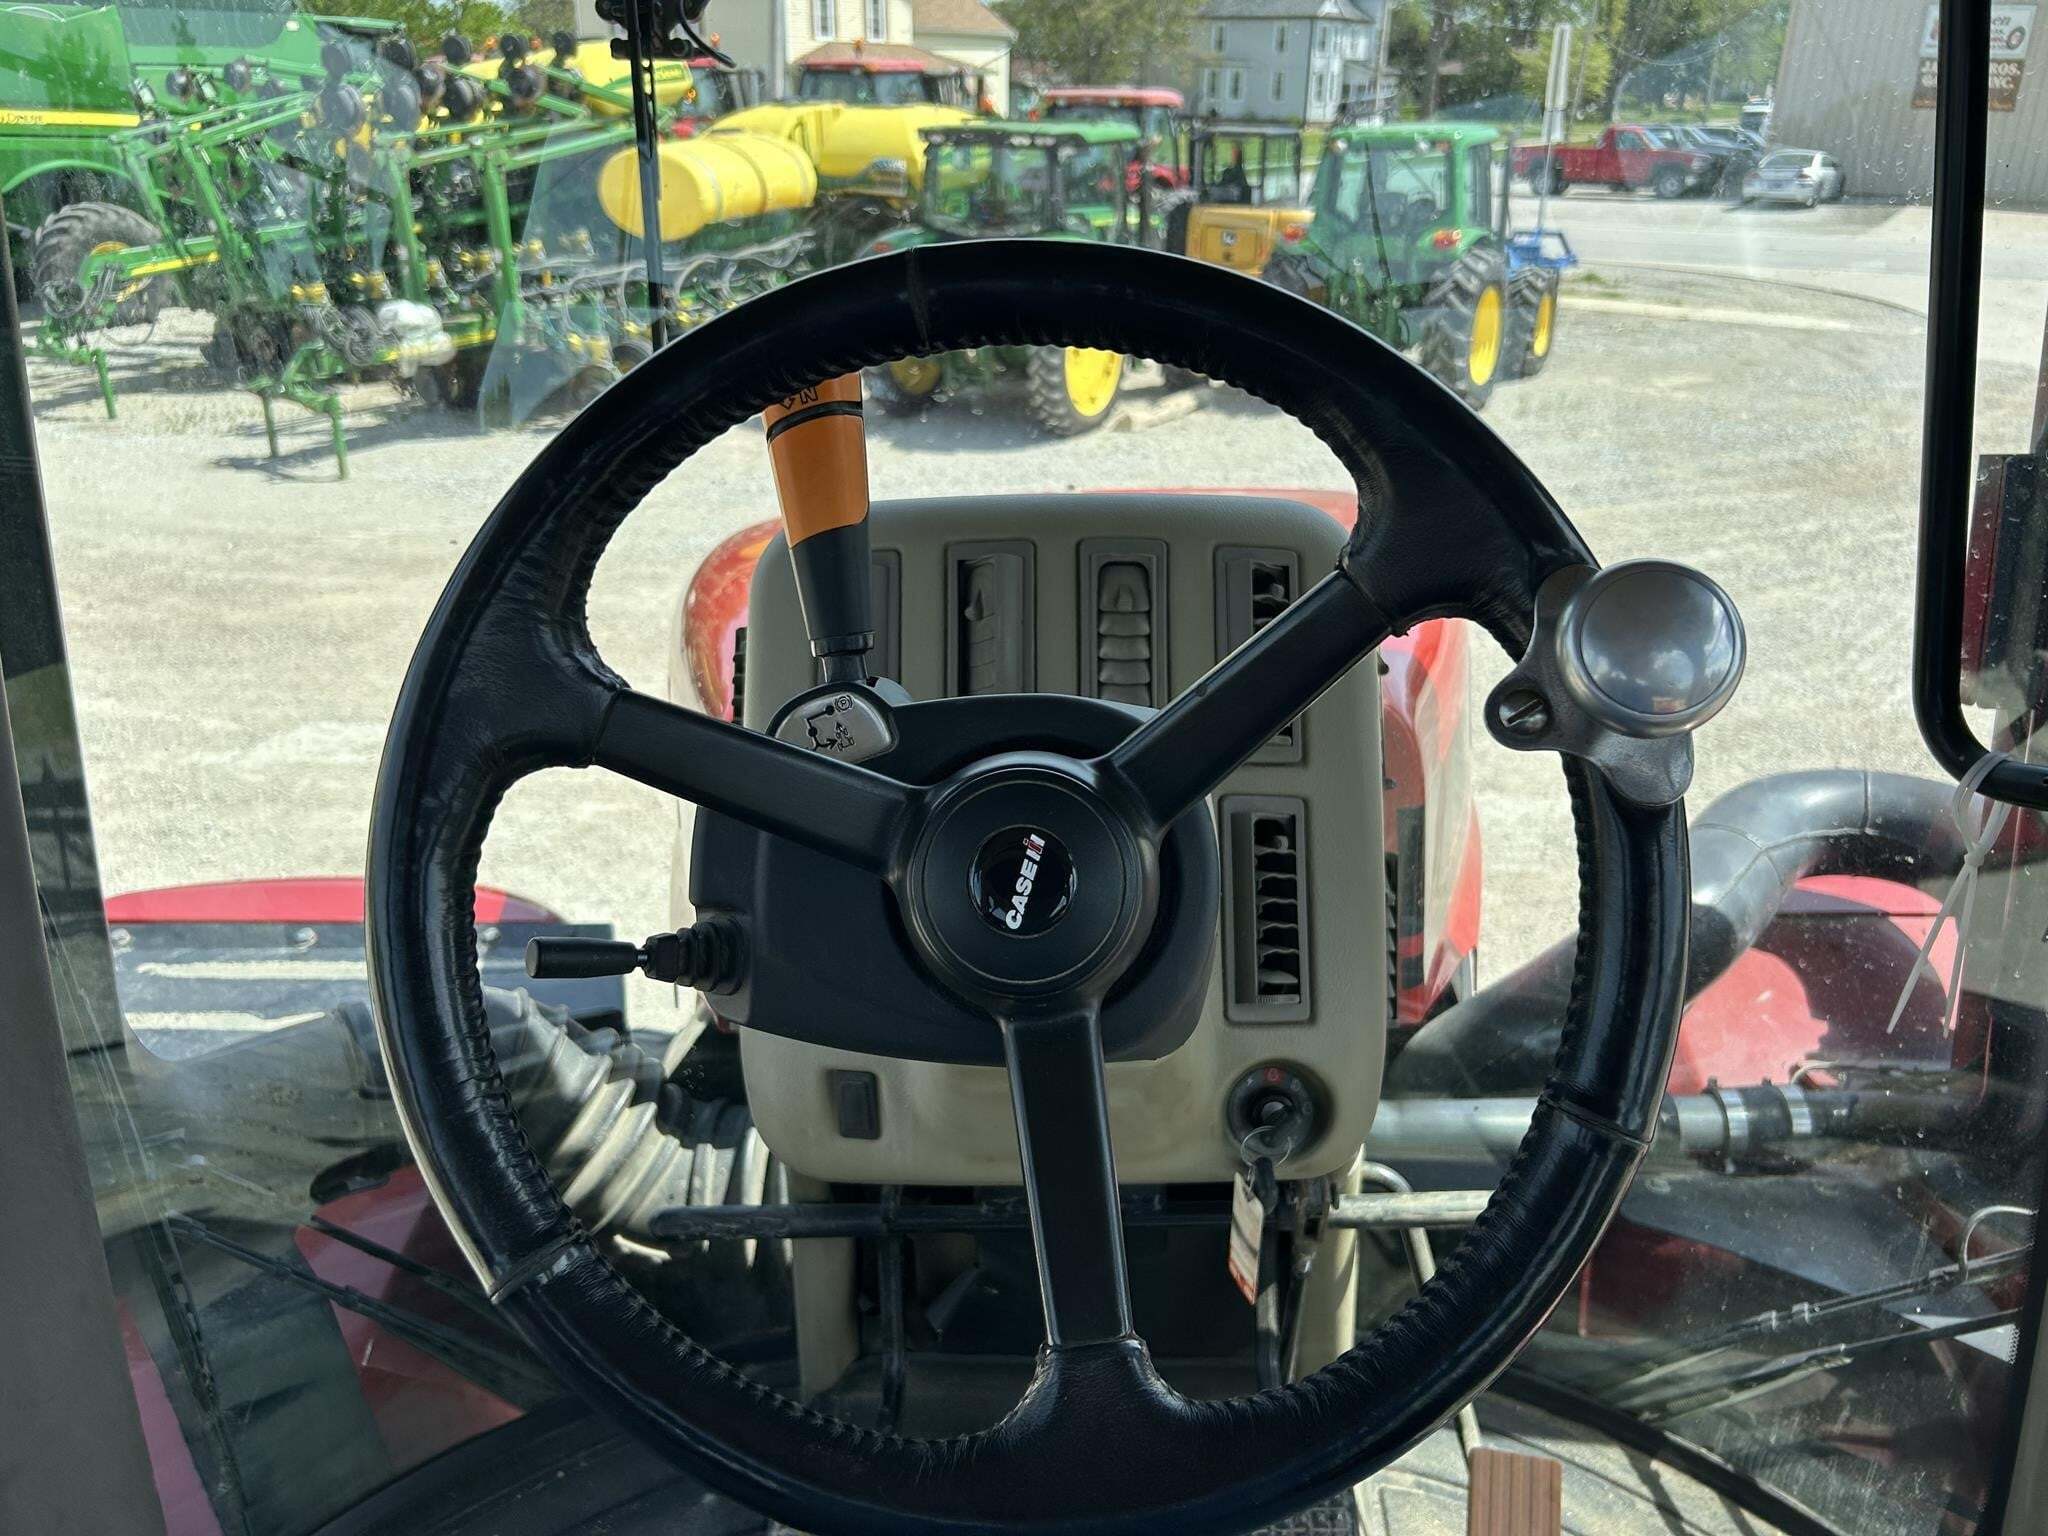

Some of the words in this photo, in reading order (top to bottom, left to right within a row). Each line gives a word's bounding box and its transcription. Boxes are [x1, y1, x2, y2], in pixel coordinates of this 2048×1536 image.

[1990, 62, 2021, 76] ROS.
[800, 386, 818, 405] N
[1006, 858, 1038, 930] CASE
